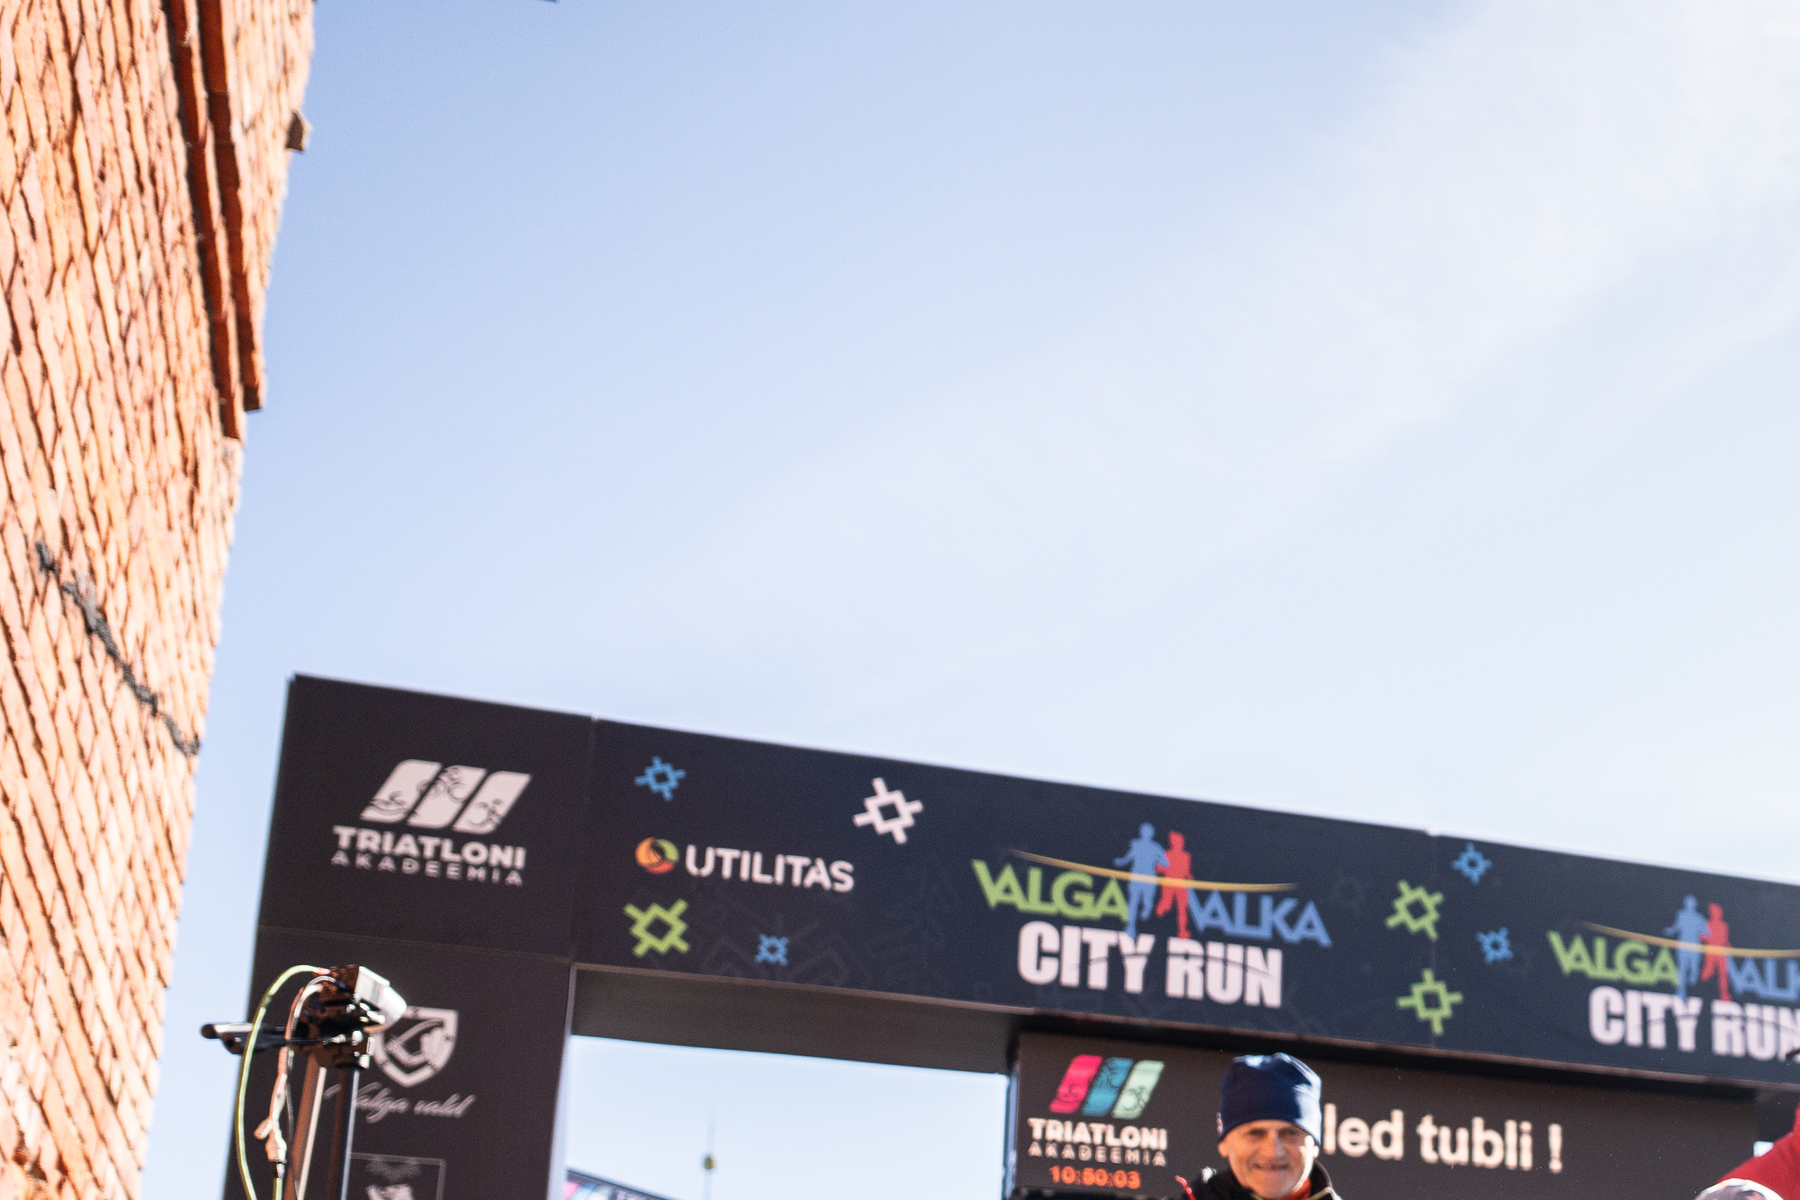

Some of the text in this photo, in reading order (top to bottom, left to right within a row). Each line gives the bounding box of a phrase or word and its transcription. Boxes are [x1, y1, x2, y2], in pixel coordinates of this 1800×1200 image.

[331, 850, 523, 887] AKADEEMIA
[332, 824, 526, 870] TRIATLONI
[685, 844, 855, 893] UTILITAS
[971, 859, 1129, 923] VALGA
[1017, 920, 1282, 1009] CITY RUN
[1547, 931, 1679, 988] VALGA
[1589, 985, 1703, 1053] CITY
[1027, 1117, 1168, 1151] TRIATLONI
[1028, 1141, 1166, 1168] AKADEEMIA
[1323, 1102, 1563, 1174] led tubli !
